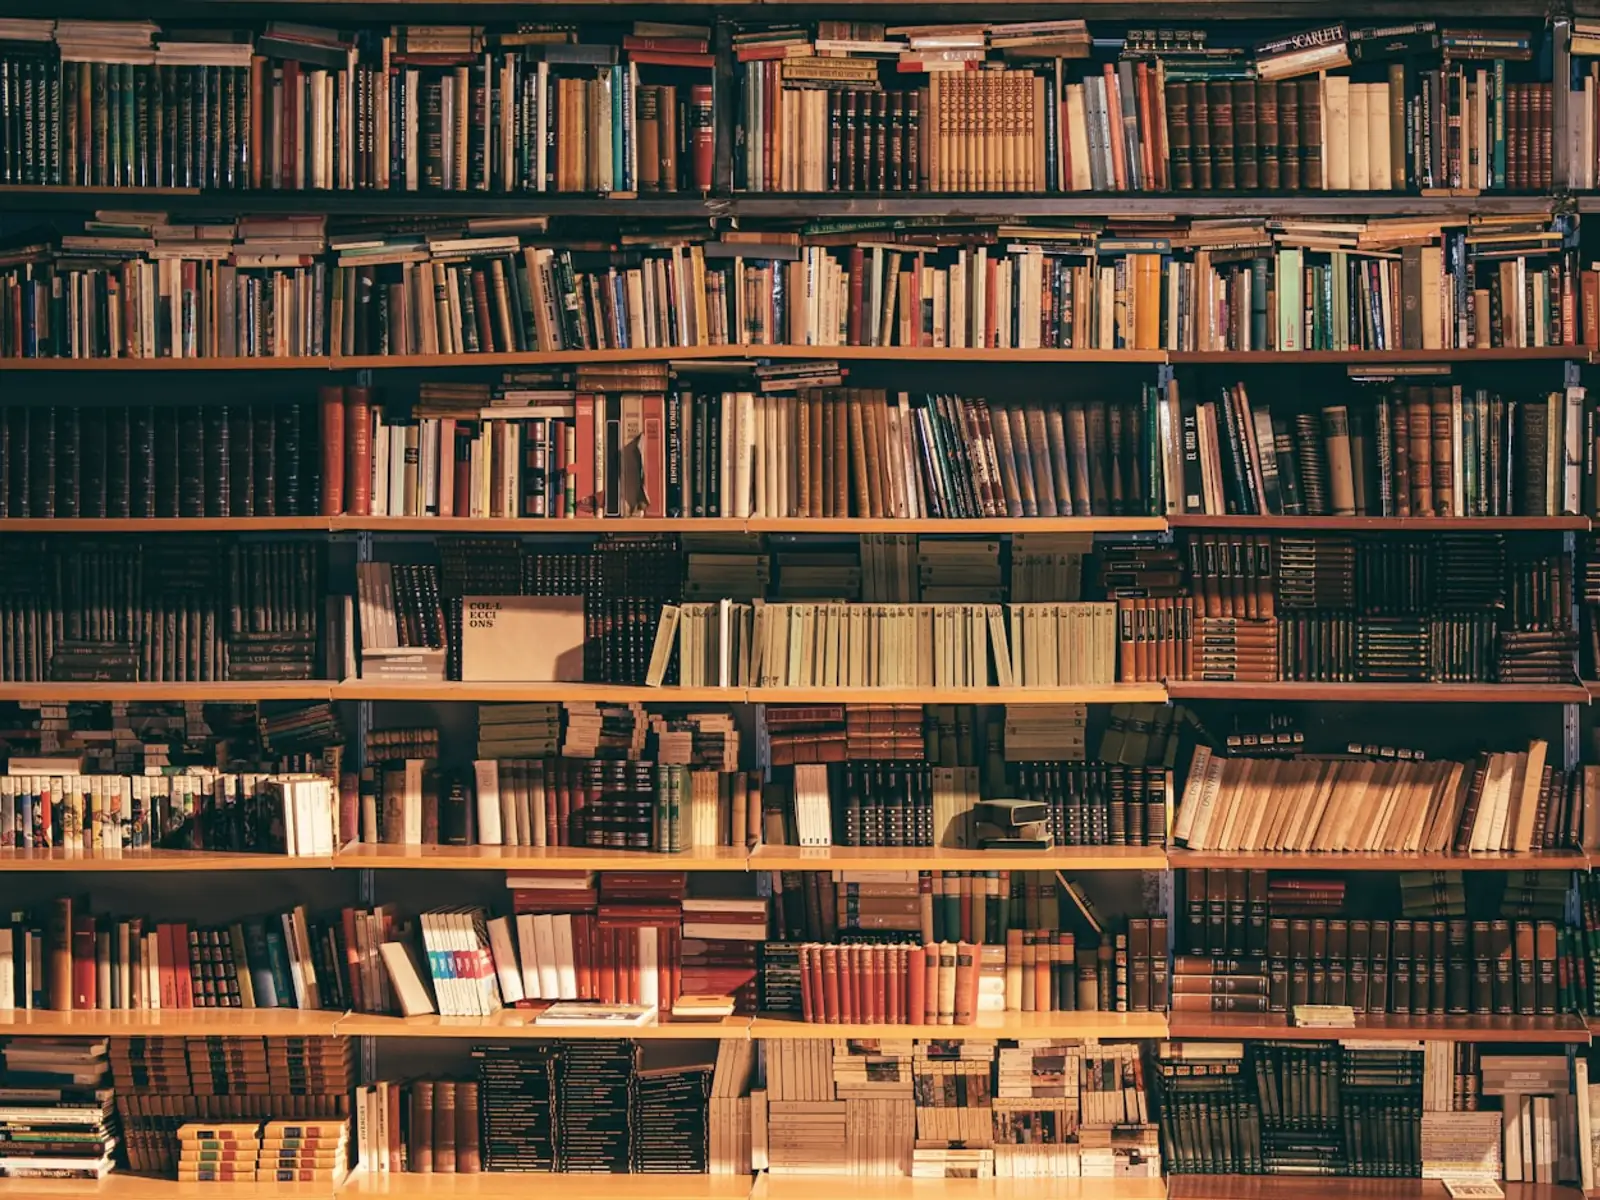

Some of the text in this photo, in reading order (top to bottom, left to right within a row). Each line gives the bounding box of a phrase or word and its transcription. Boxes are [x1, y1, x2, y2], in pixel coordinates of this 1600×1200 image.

[1291, 25, 1343, 50] SCARLETT
[25, 121, 33, 148] RAZAS
[38, 122, 46, 150] RAZAS
[940, 77, 948, 137] BRICOLAJE
[949, 77, 957, 137] BRICOLAJE
[958, 77, 966, 137] BRICOLAJE
[967, 77, 975, 137] BRICOLAJE
[976, 77, 984, 137] BRICOLAJE
[993, 77, 1003, 137] BRICOLAJE
[1004, 77, 1013, 137] BRICOLAJE
[1015, 77, 1023, 137] BRICOLAJE
[1024, 77, 1033, 137] BRICOLAJE
[25, 149, 33, 166] LAS
[38, 150, 46, 167] LAS
[1185, 416, 1197, 460] EL SIGLO XX
[469, 611, 496, 619] ECCI
[469, 620, 493, 628] ONS
